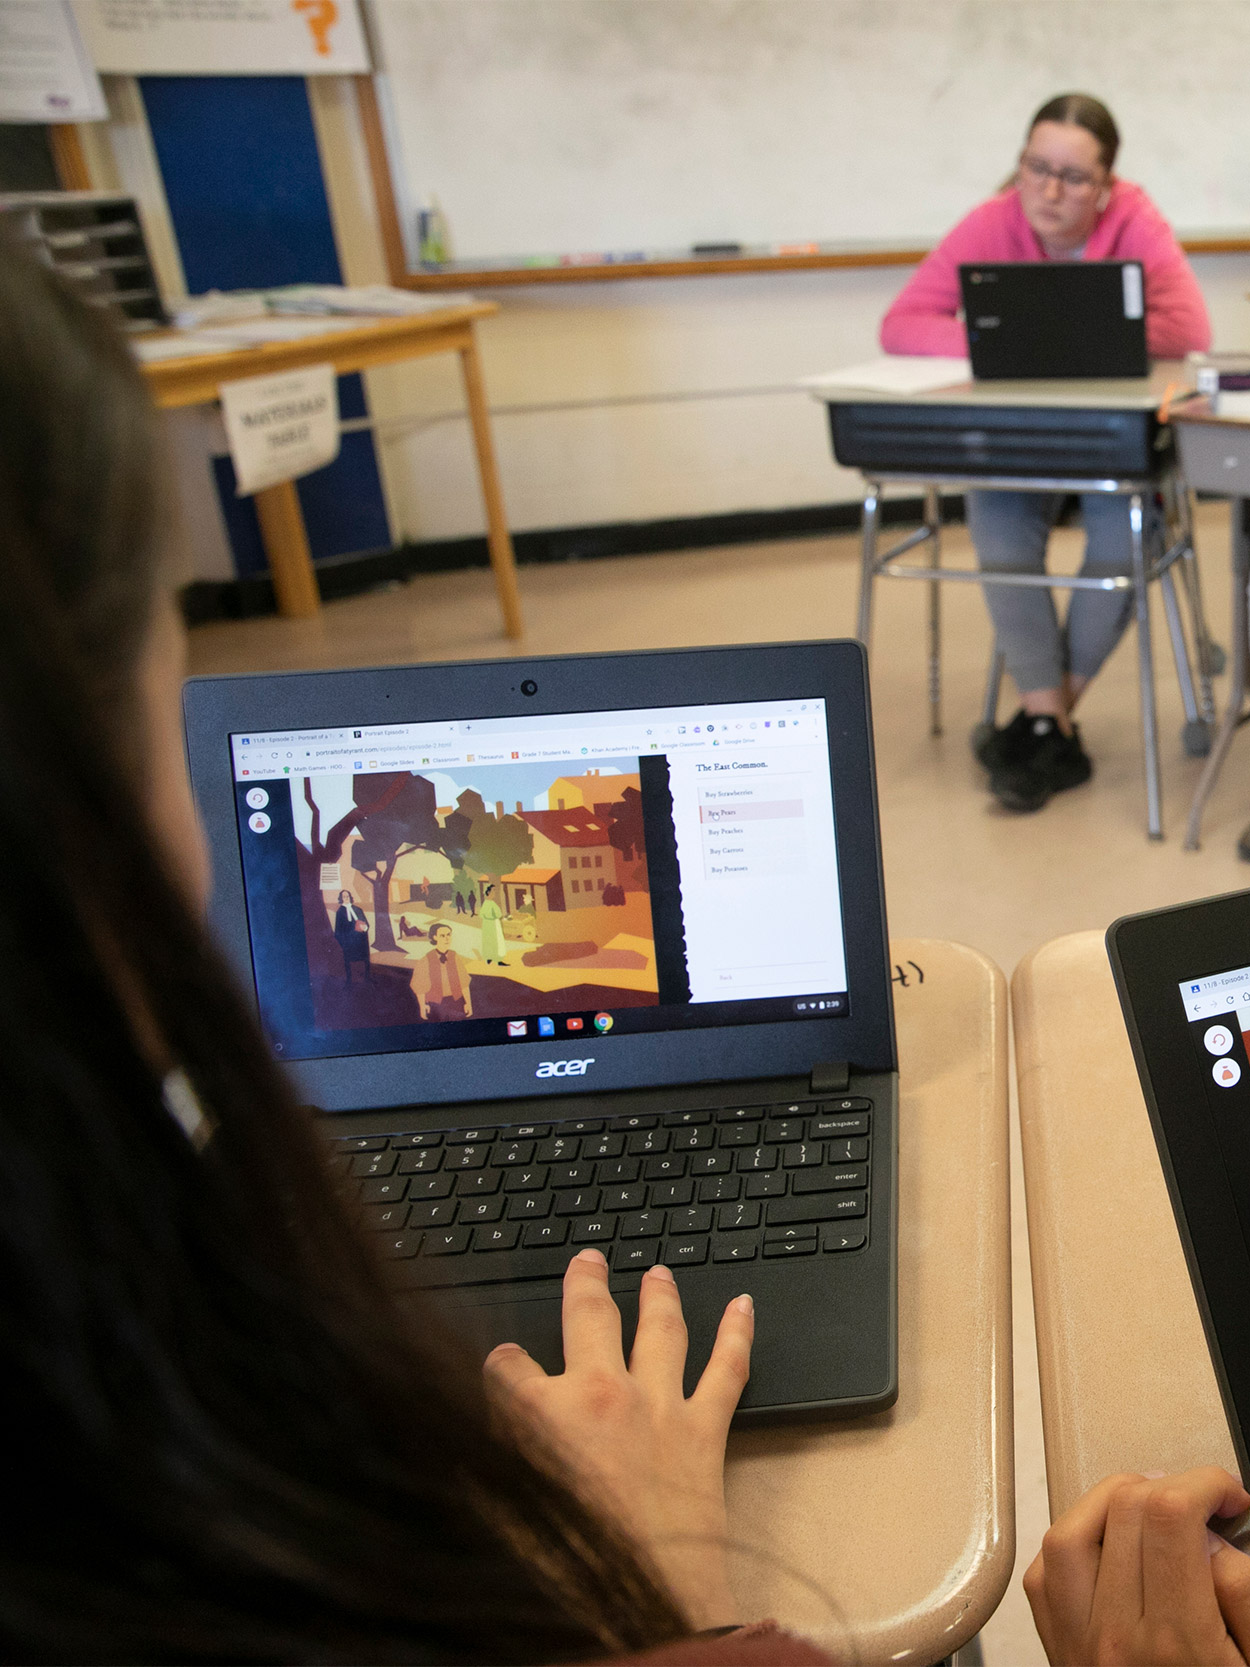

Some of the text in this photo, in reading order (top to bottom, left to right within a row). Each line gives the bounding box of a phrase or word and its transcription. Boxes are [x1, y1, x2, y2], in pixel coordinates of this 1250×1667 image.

[380, 760, 398, 768] Google
[696, 762, 768, 772] The East Common.
[710, 848, 721, 856] Buy
[1203, 980, 1218, 990] 11/8
[1220, 974, 1244, 986] Episode
[536, 1058, 596, 1078] acer
[522, 1174, 530, 1182] y
